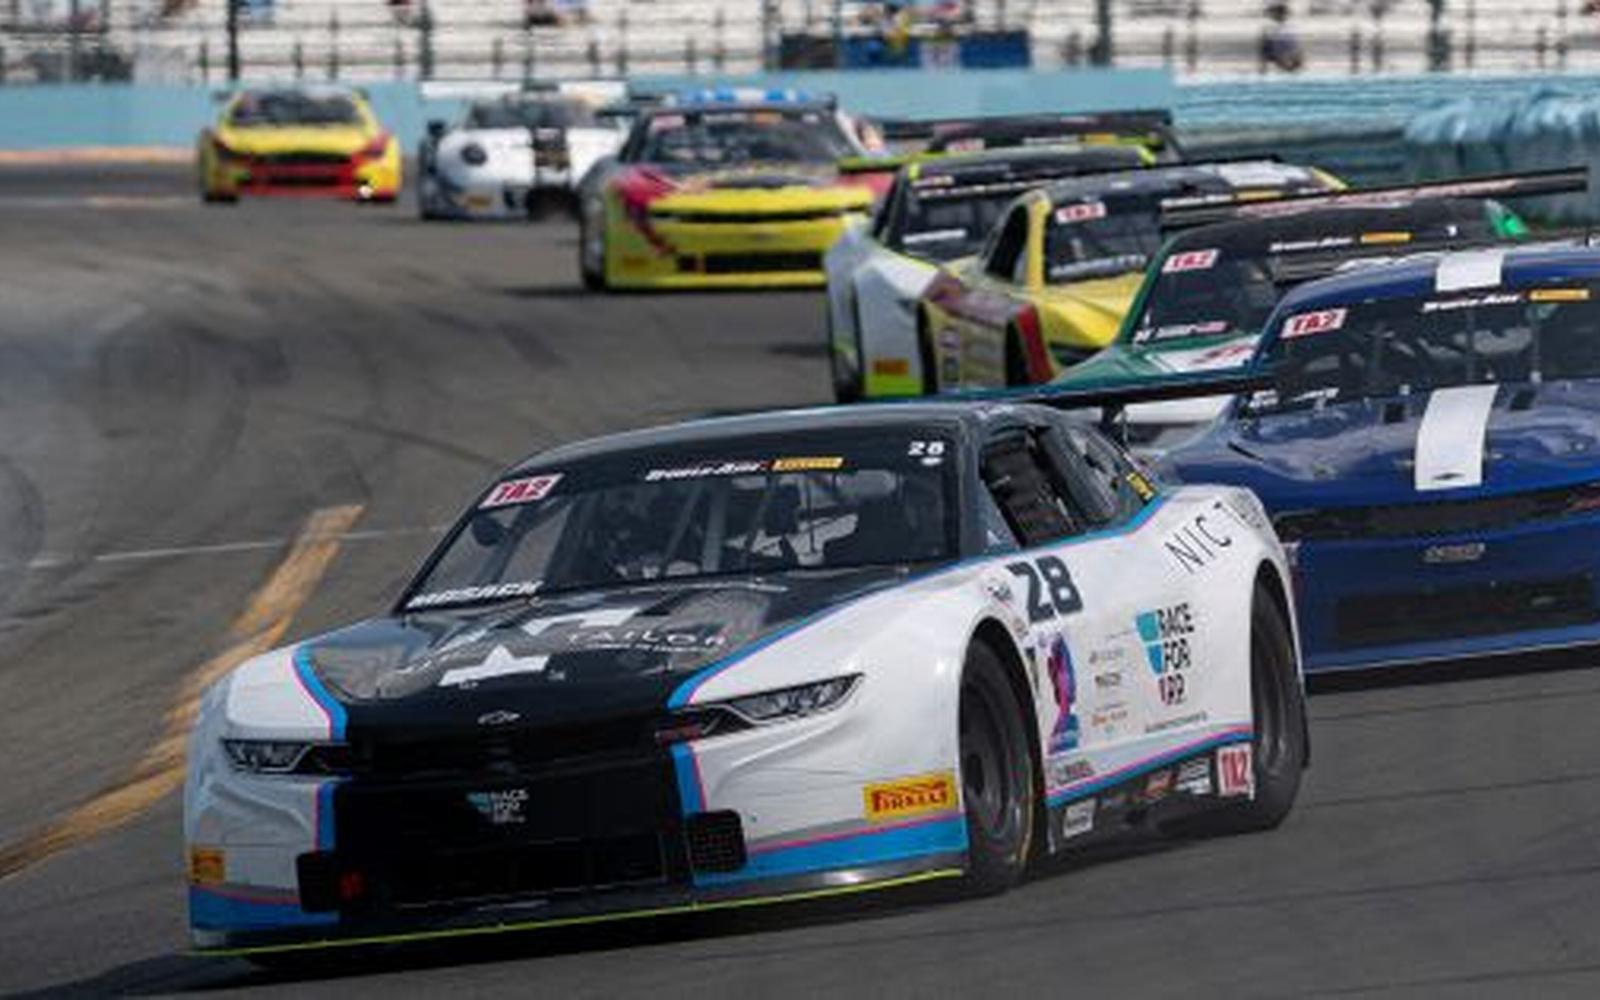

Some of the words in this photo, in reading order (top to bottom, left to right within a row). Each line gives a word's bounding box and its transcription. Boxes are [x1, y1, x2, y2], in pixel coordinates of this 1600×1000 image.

[1292, 312, 1338, 333] TA2
[907, 441, 945, 456] 28
[492, 479, 553, 502] TA2
[1164, 515, 1233, 575] NIC
[1006, 555, 1084, 624] 28
[872, 781, 948, 813] PIRELLI
